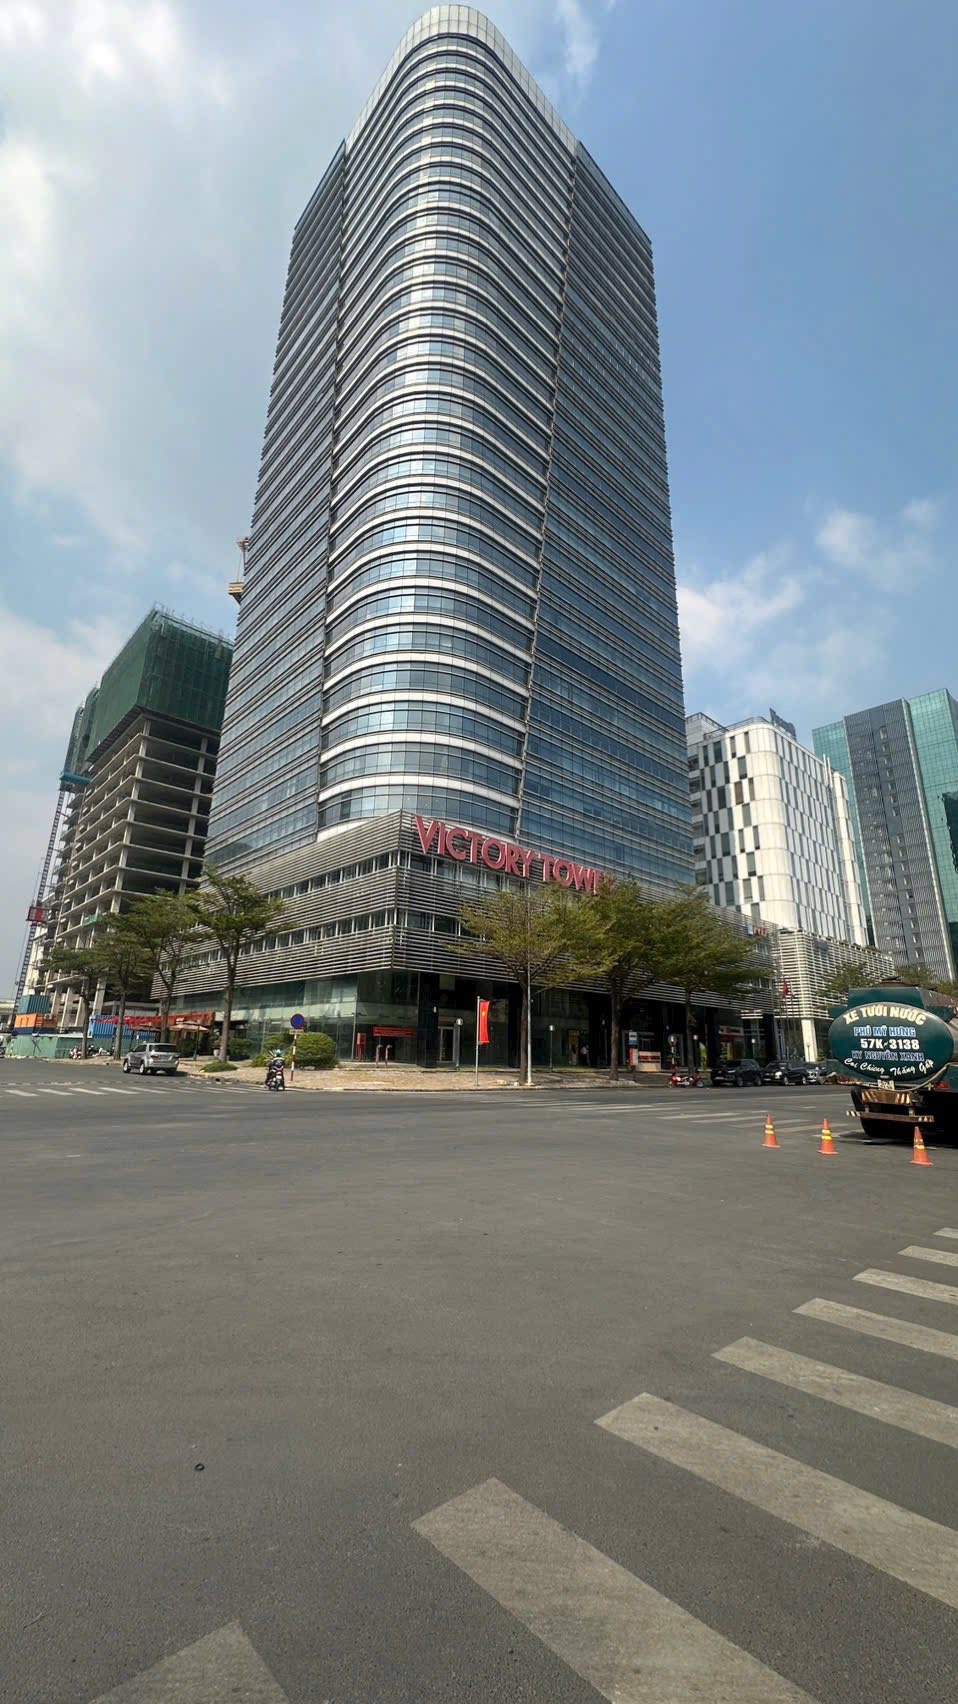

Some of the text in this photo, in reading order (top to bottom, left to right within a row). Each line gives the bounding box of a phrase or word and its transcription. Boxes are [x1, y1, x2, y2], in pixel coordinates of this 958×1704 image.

[415, 815, 617, 896] VICTORY TOW
[843, 1010, 859, 1024] XE
[872, 1025, 888, 1037] MỸ
[860, 1038, 920, 1050] 57K-3138
[899, 1051, 925, 1062] XANH
[844, 1058, 858, 1068] Coi
